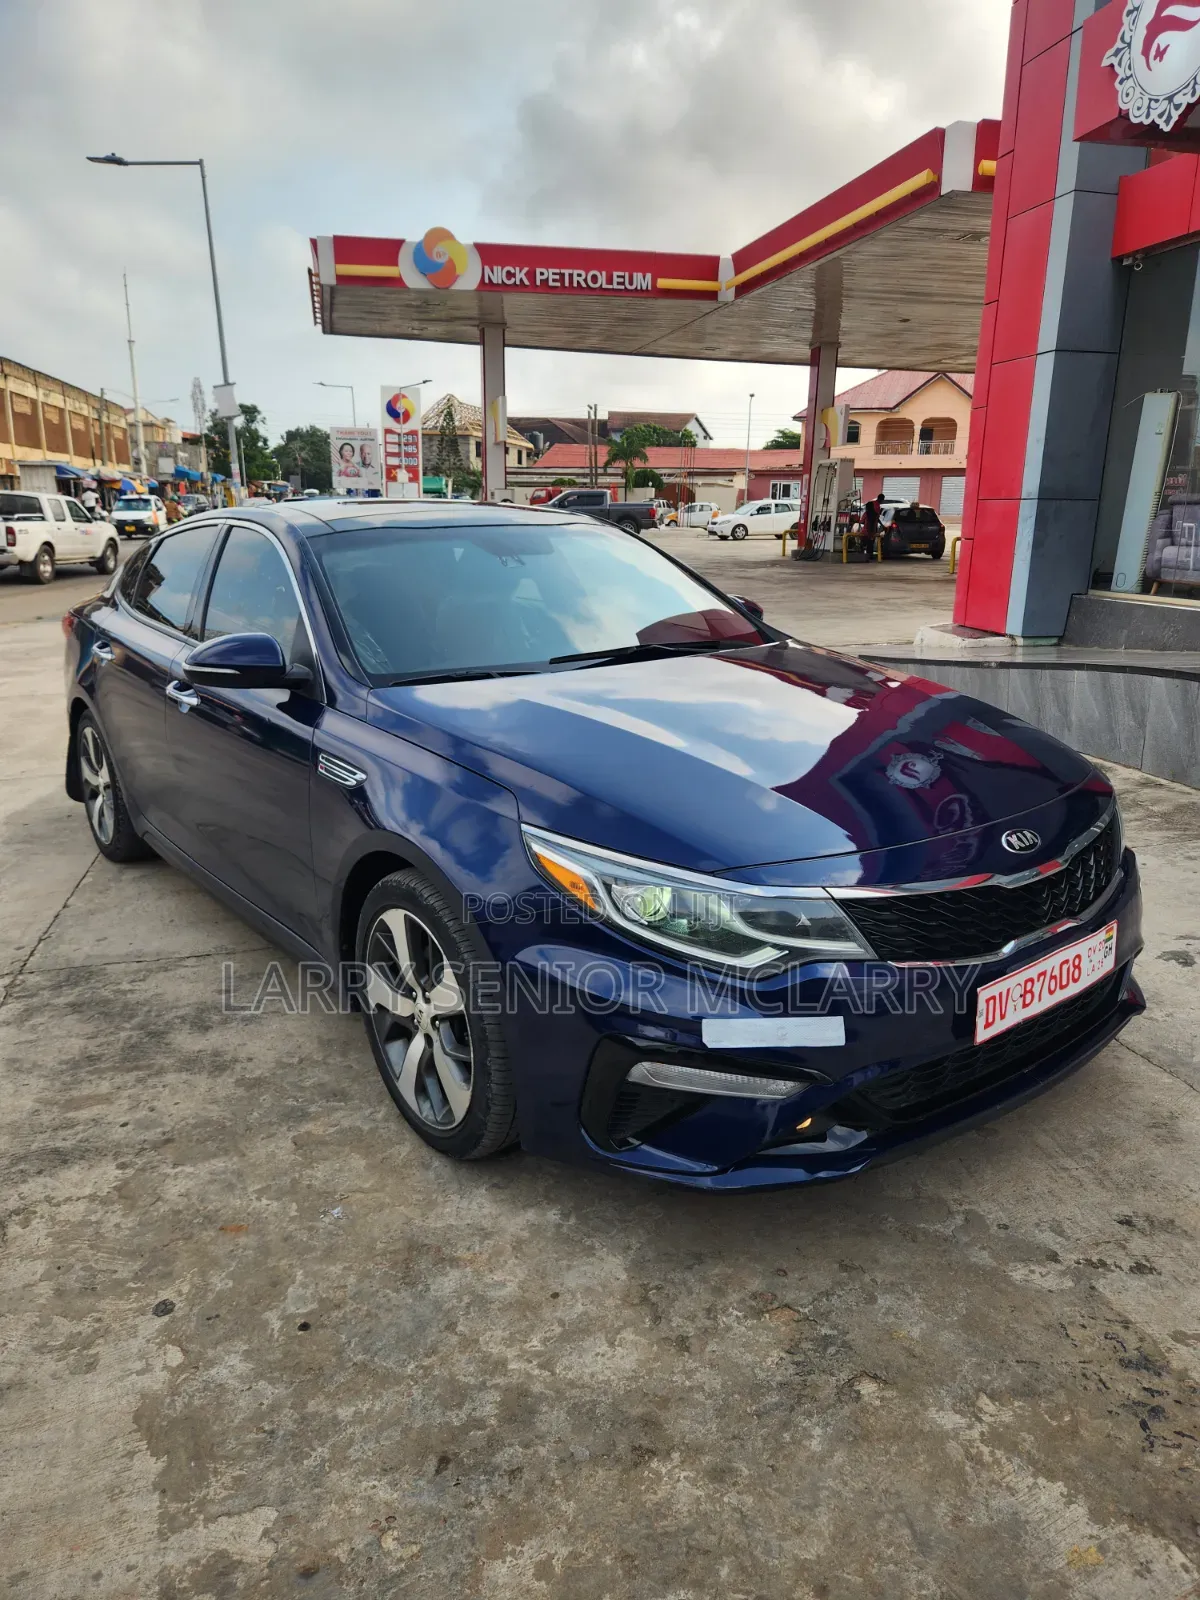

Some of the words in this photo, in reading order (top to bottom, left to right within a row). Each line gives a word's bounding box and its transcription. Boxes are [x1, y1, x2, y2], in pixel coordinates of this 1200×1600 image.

[483, 265, 530, 286] NICK
[535, 267, 652, 291] PETROLEUM
[1006, 830, 1039, 850] KIA
[984, 987, 1011, 1030] DV
[1022, 953, 1082, 1010] B7608
